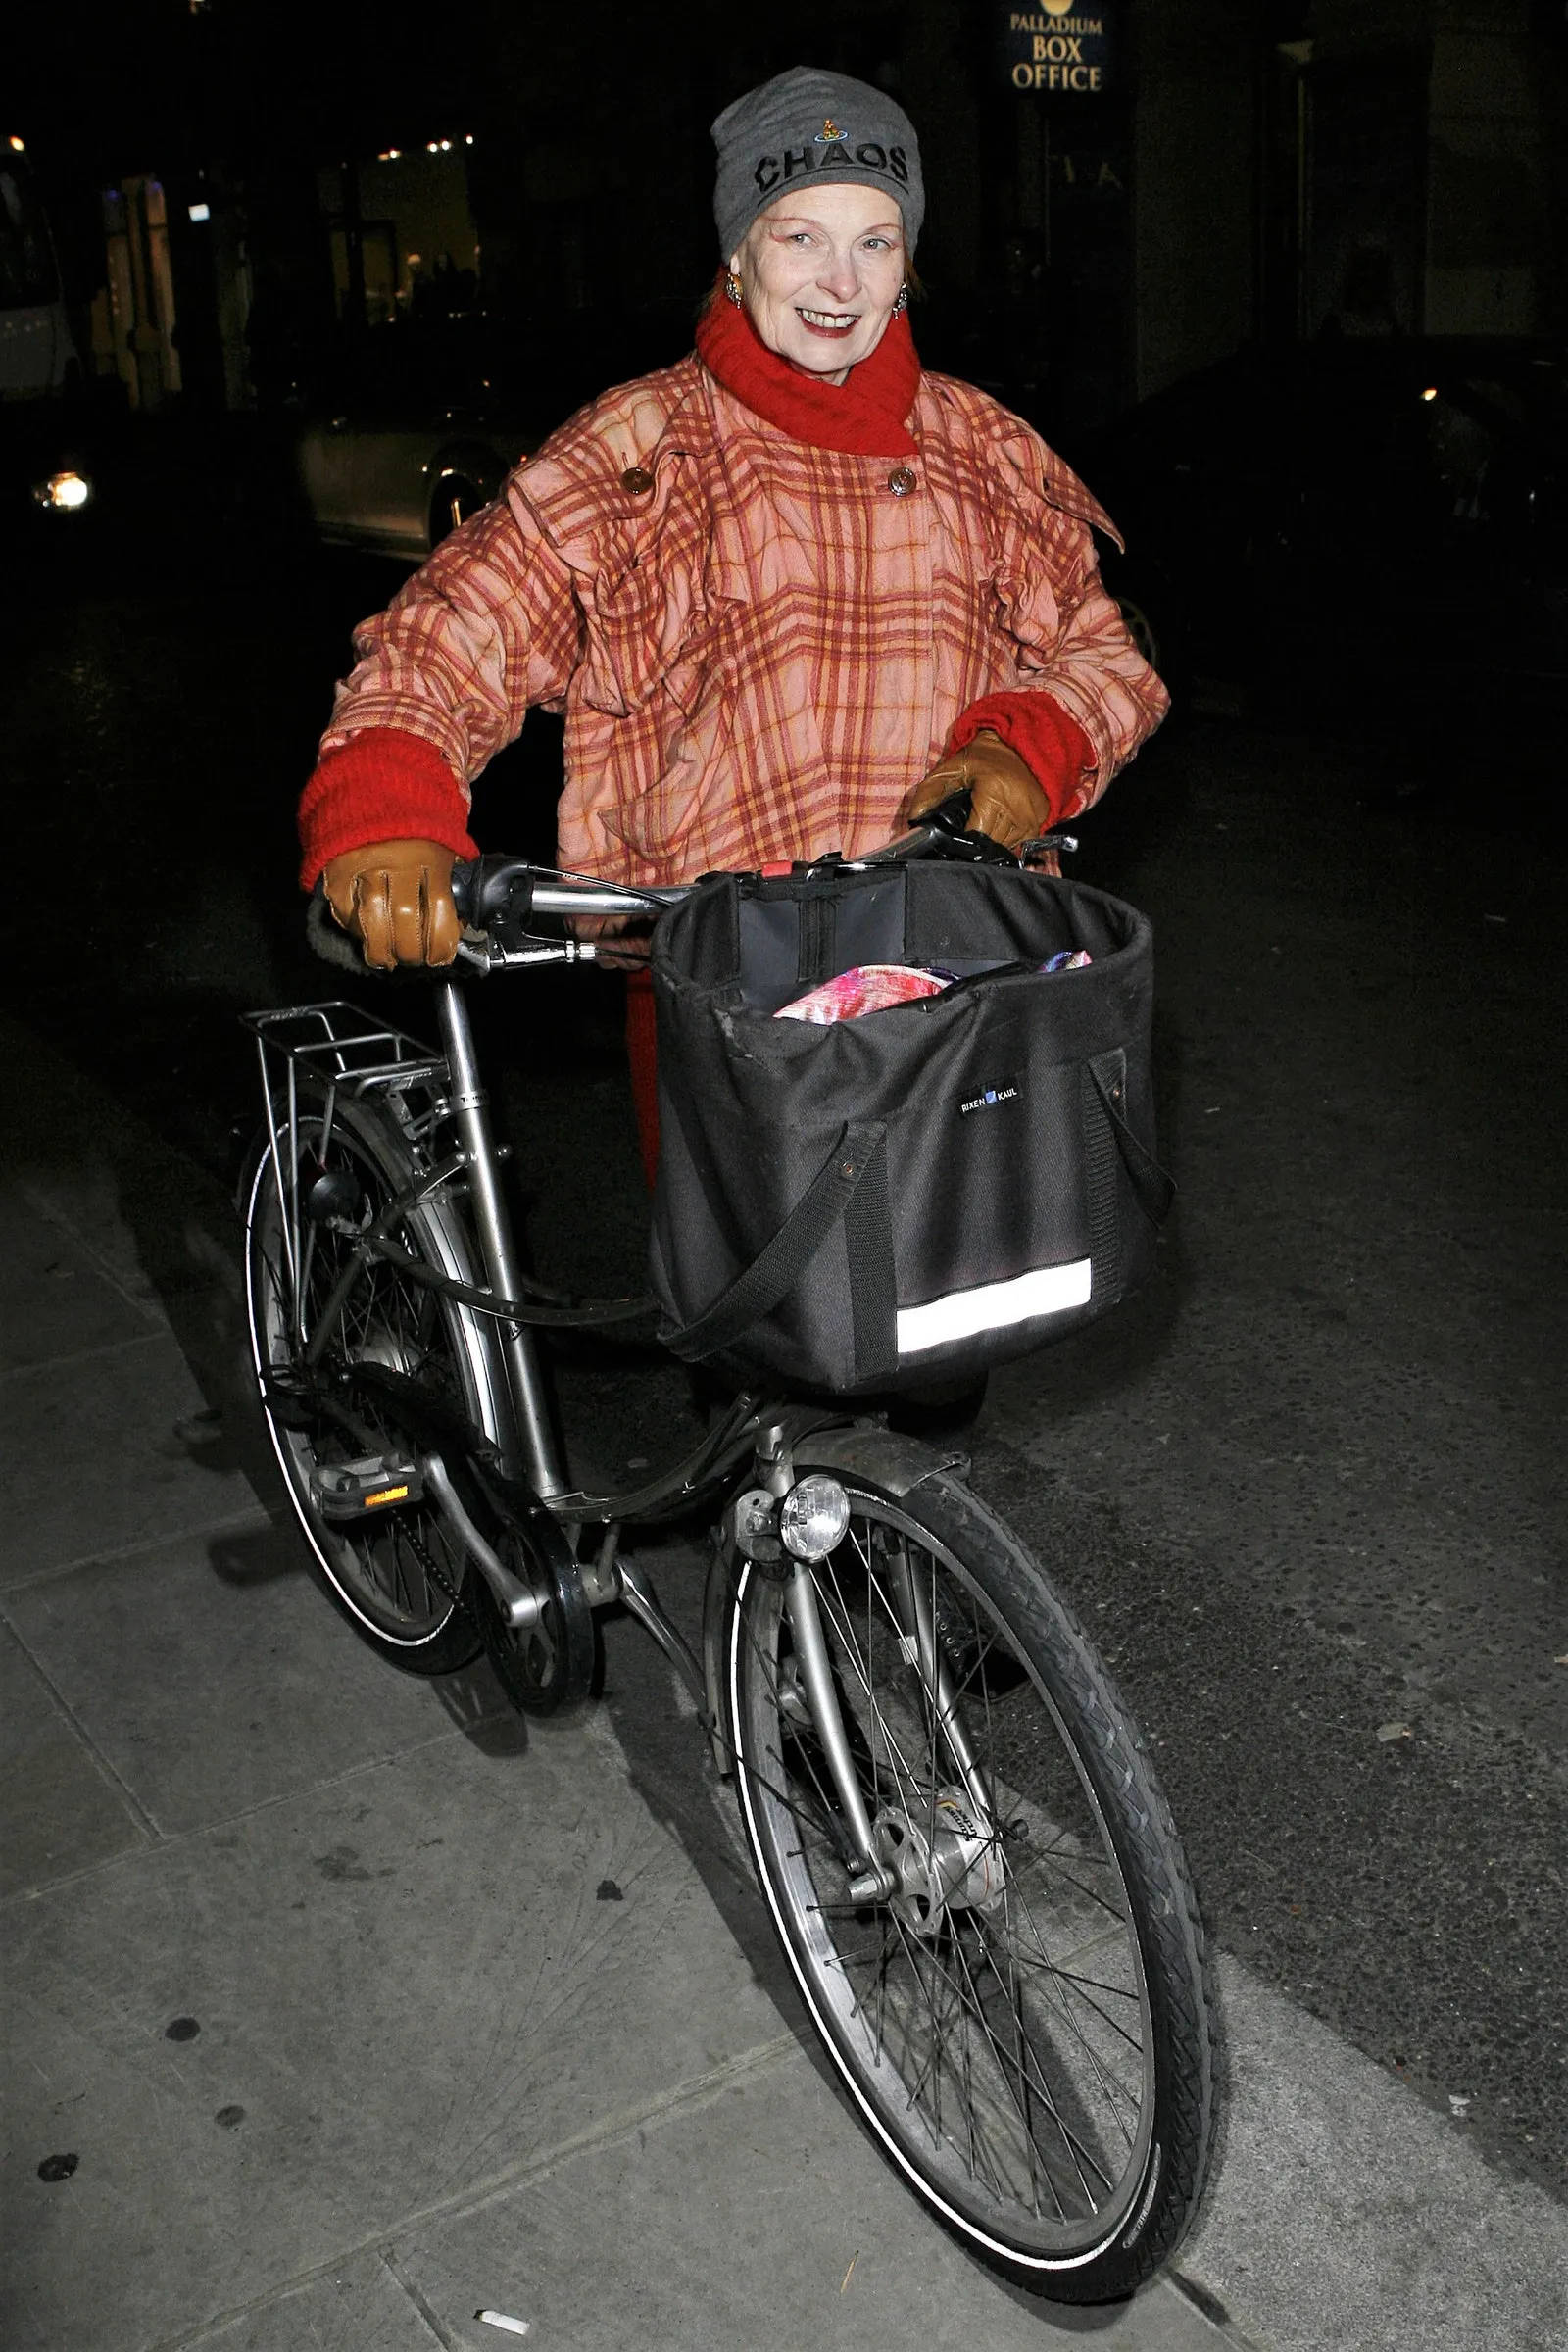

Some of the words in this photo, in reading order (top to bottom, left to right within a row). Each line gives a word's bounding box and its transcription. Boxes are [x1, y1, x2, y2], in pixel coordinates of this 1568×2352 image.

[1010, 13, 1102, 35] PALLADIUM
[1032, 35, 1082, 63] BOX
[1011, 63, 1102, 91] OFFICE
[754, 143, 908, 193] CHAOS
[961, 1098, 986, 1113] RIXEN
[997, 1088, 1018, 1101] KAUL
